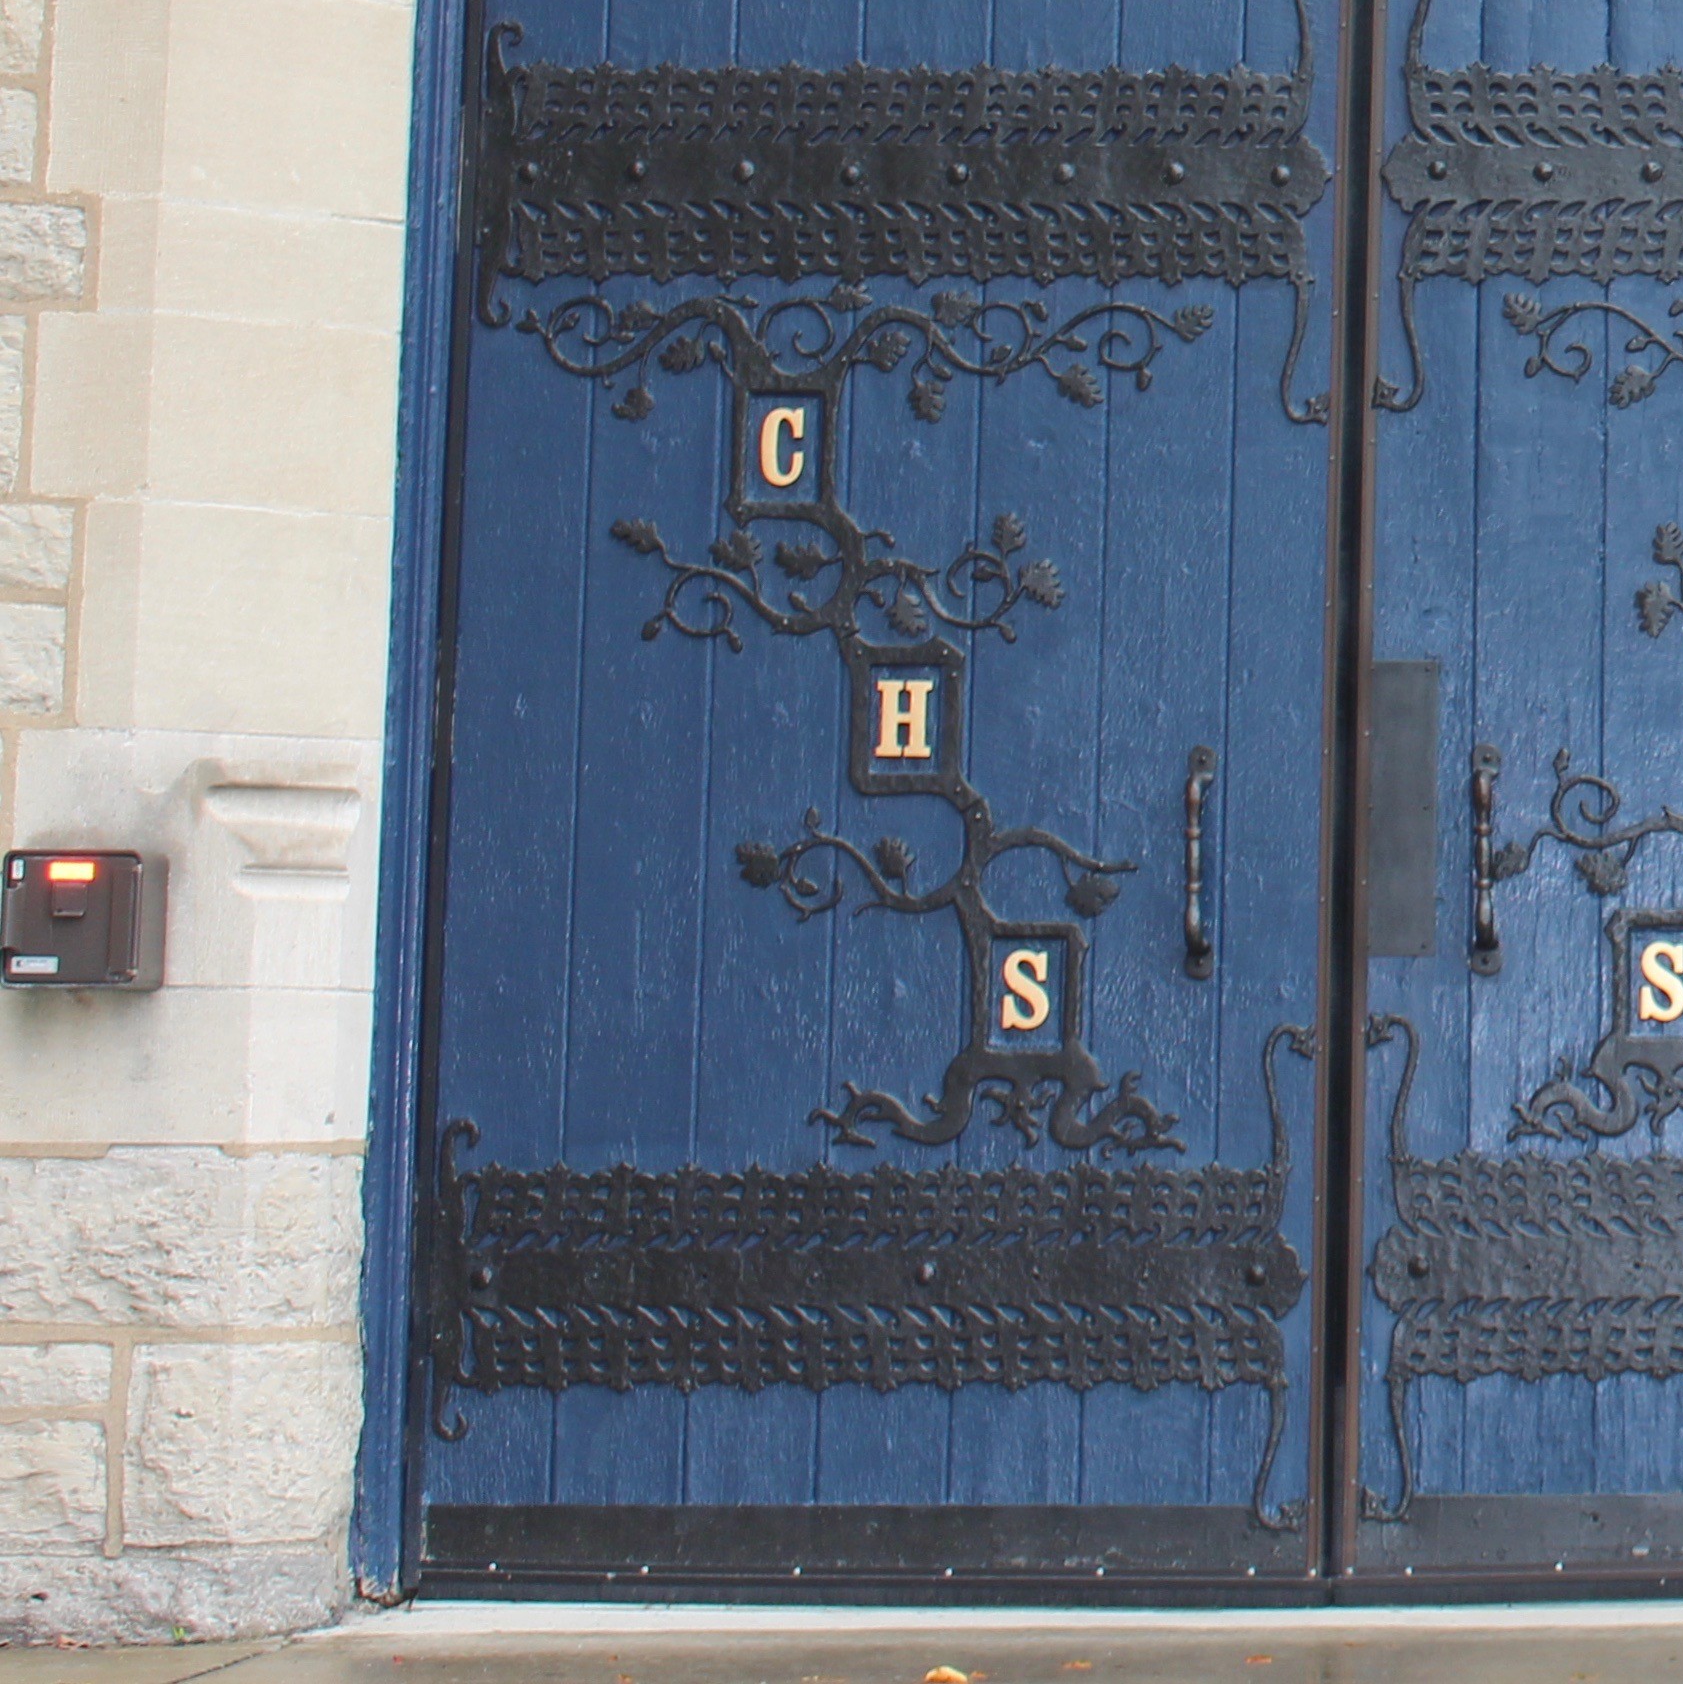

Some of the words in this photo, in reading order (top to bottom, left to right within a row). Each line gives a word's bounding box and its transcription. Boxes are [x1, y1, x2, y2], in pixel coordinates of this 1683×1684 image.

[761, 408, 804, 486] C
[875, 680, 933, 757] H
[1002, 950, 1049, 1030] S
